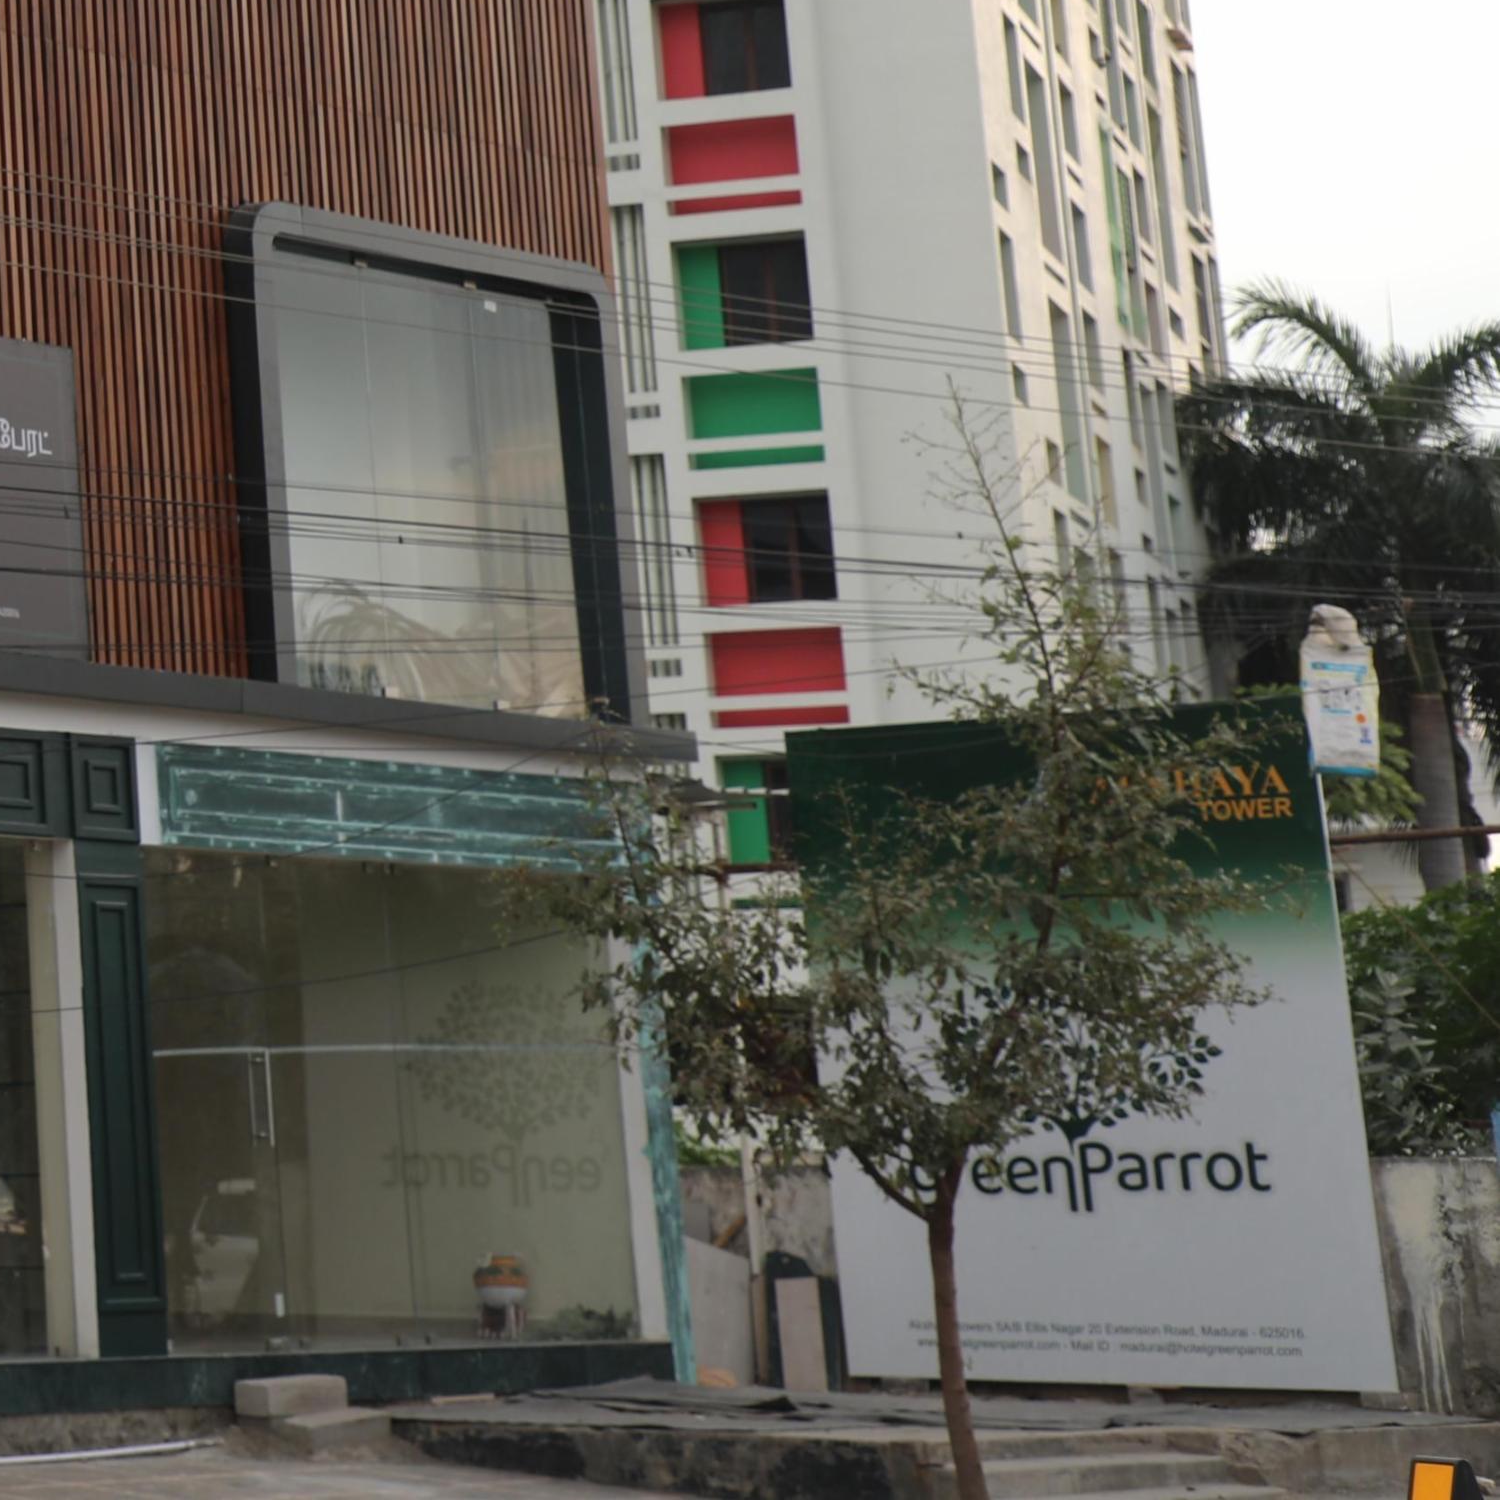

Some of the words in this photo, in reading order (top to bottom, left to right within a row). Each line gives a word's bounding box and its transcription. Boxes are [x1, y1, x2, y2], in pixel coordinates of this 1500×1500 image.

[1196, 796, 1294, 821] TOWER
[910, 1140, 1272, 1213] eenParrot
[1050, 1323, 1084, 1336] Nagar
[1104, 1323, 1161, 1335] Extension
[1200, 1325, 1249, 1338] Madurai
[1070, 1340, 1094, 1351] Mail
